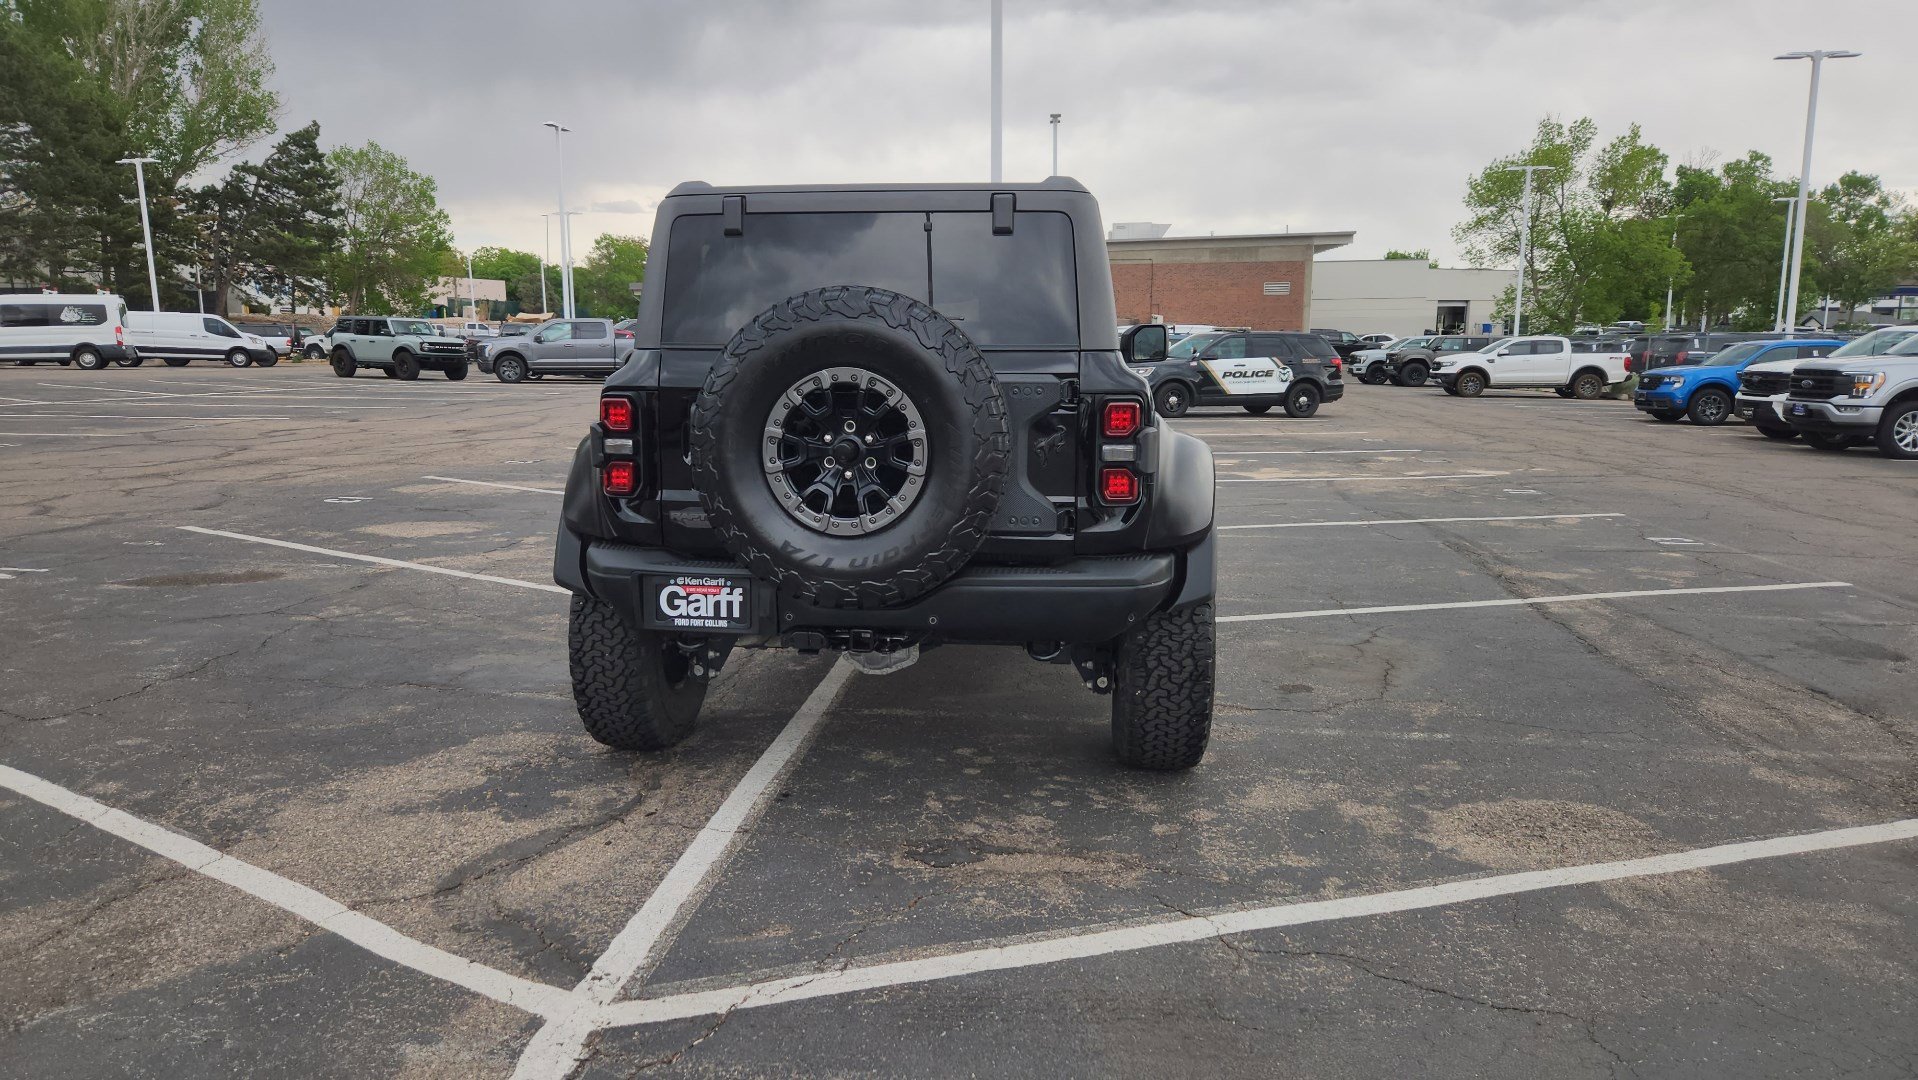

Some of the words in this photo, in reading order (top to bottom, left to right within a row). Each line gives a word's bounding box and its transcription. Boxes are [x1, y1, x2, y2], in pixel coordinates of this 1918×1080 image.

[1222, 369, 1275, 379] POLICE
[685, 577, 702, 585] Ken
[703, 577, 725, 586] Garff
[660, 585, 743, 618] Garff
[675, 618, 689, 626] FORD
[690, 618, 704, 627] FORT
[705, 619, 728, 628] COLLINS
